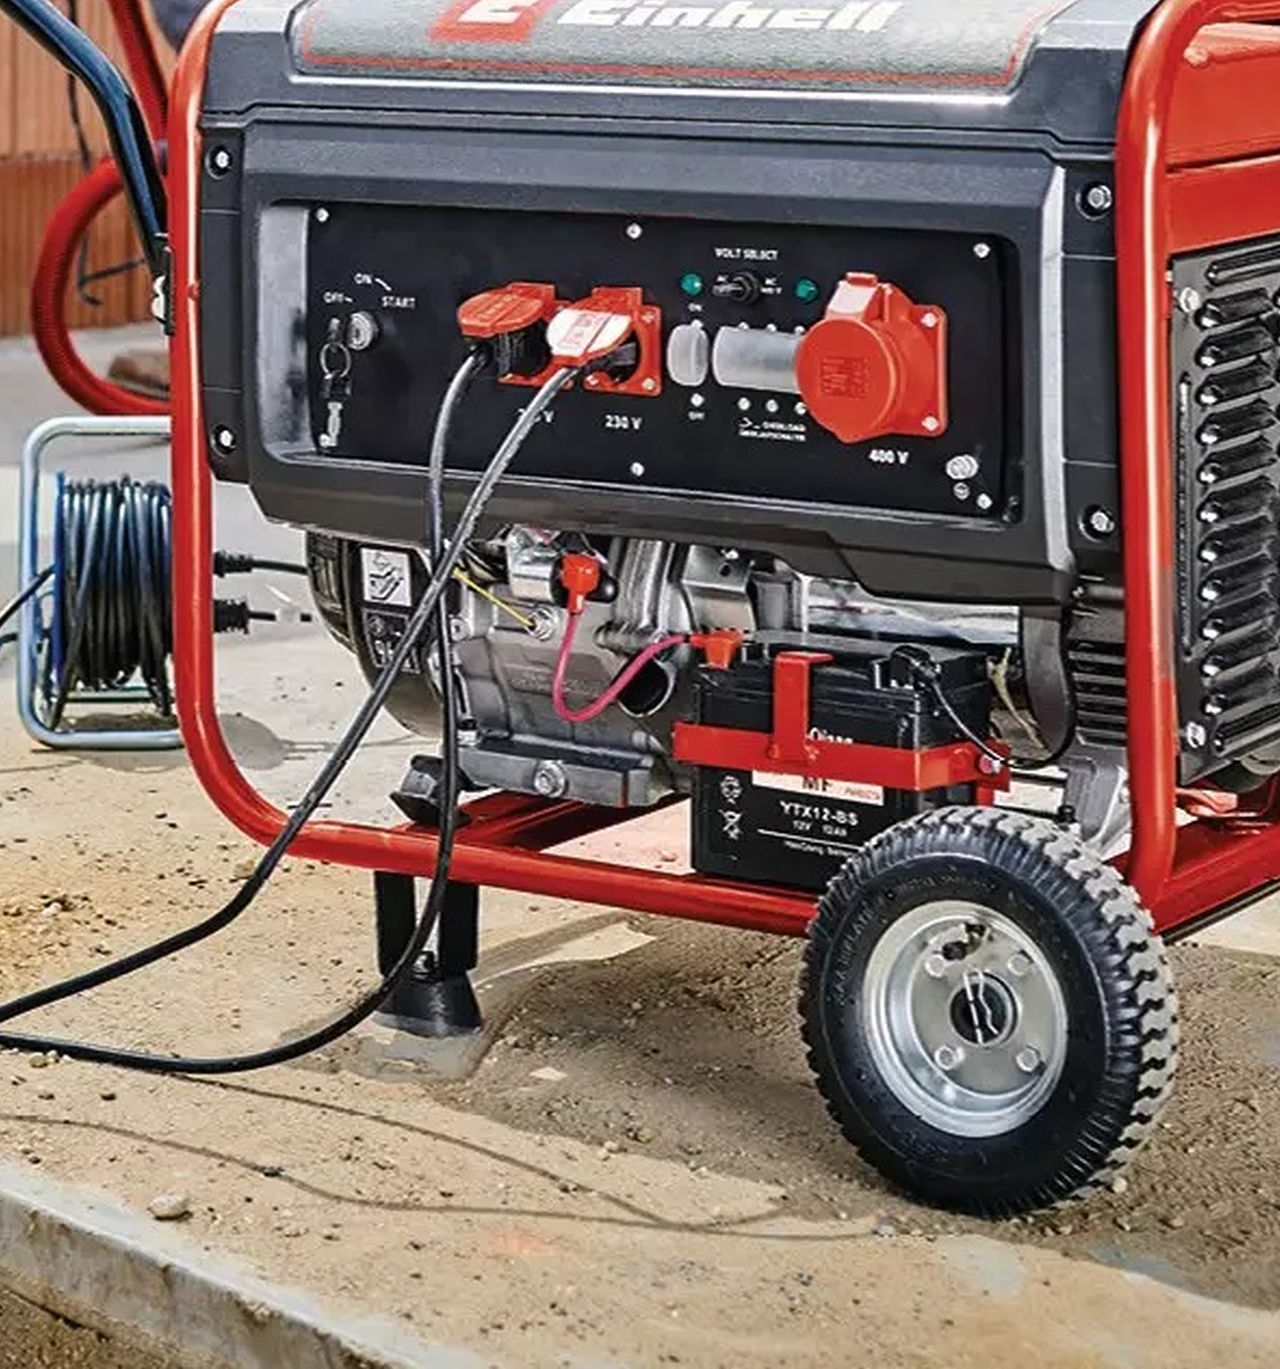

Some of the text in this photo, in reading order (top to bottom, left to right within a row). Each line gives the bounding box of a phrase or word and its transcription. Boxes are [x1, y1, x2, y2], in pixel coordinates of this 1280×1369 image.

[714, 247, 779, 260] VOLT SELECT
[353, 273, 372, 284] ON
[381, 296, 416, 309] START
[605, 414, 643, 430] 230 V
[869, 449, 910, 465] 400 V
[779, 800, 859, 826] YTX12-BS
